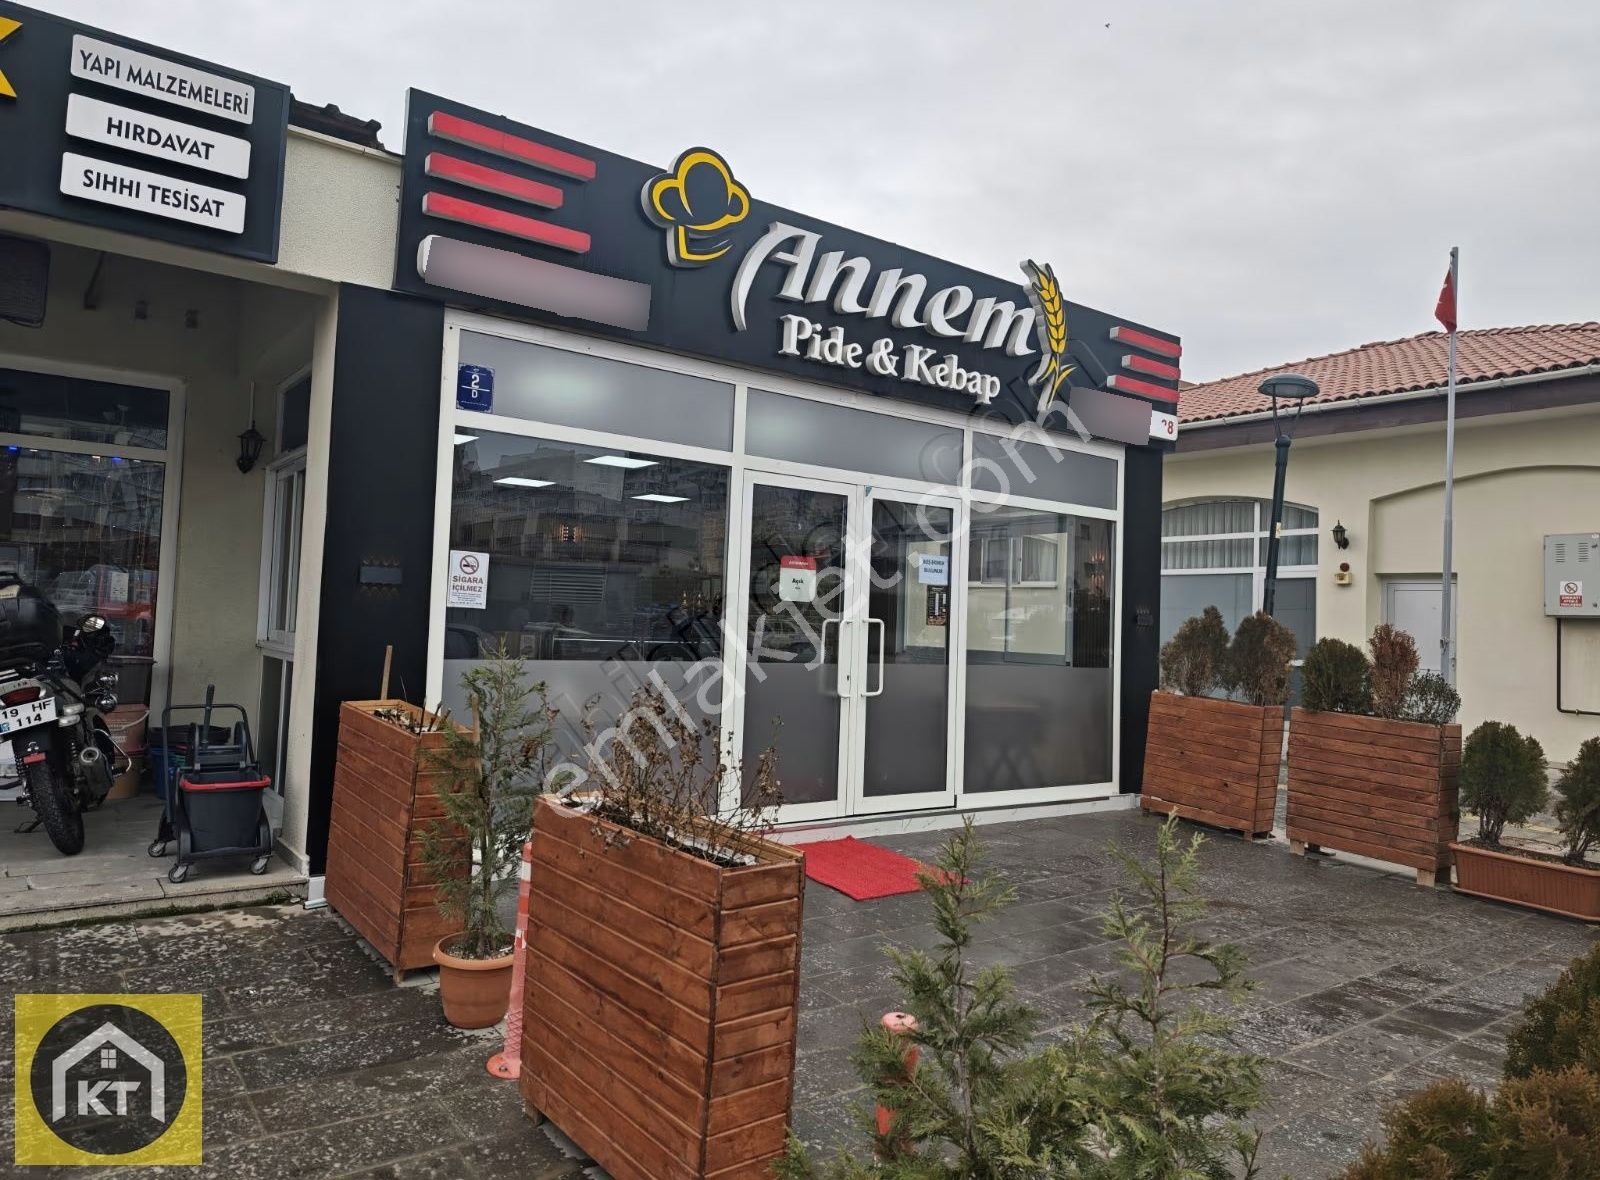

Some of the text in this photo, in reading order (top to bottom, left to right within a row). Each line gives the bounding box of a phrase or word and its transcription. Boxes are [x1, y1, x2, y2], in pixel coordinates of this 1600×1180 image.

[80, 49, 249, 115] YAPI MALZEMELERİ
[106, 116, 215, 160] HIRDAVAT
[82, 168, 225, 218] SIHHI TESİSAT
[731, 221, 1037, 357] Annem
[777, 314, 1001, 405] Pide & Kebap
[471, 373, 480, 389] 2
[452, 574, 484, 584] SİGARA
[452, 582, 483, 593] İÇİLMEZ
[2, 699, 53, 719] 19 HF
[16, 713, 42, 727] 114
